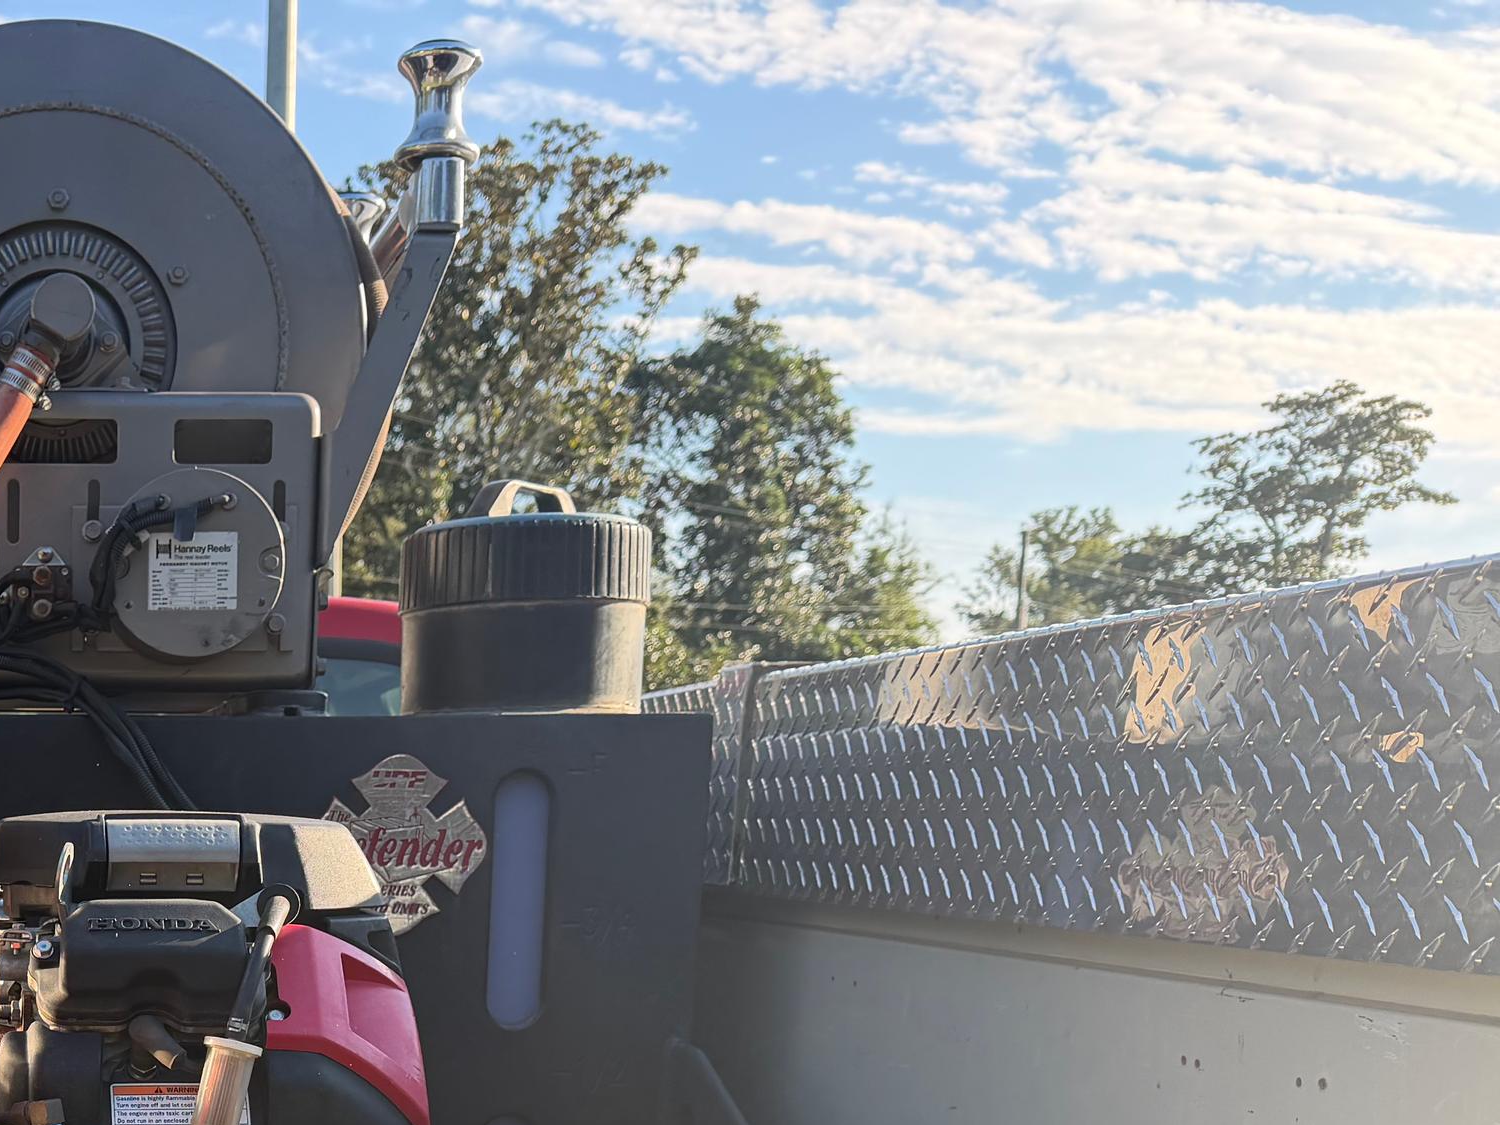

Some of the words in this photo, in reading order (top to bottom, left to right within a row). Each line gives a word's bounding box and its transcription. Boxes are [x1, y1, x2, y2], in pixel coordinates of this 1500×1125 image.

[174, 544, 206, 554] Hannay
[207, 544, 231, 553] Reels
[325, 809, 350, 822] The
[381, 884, 418, 897] ERIES
[391, 902, 430, 915] UNITS
[88, 917, 222, 931] HONDA
